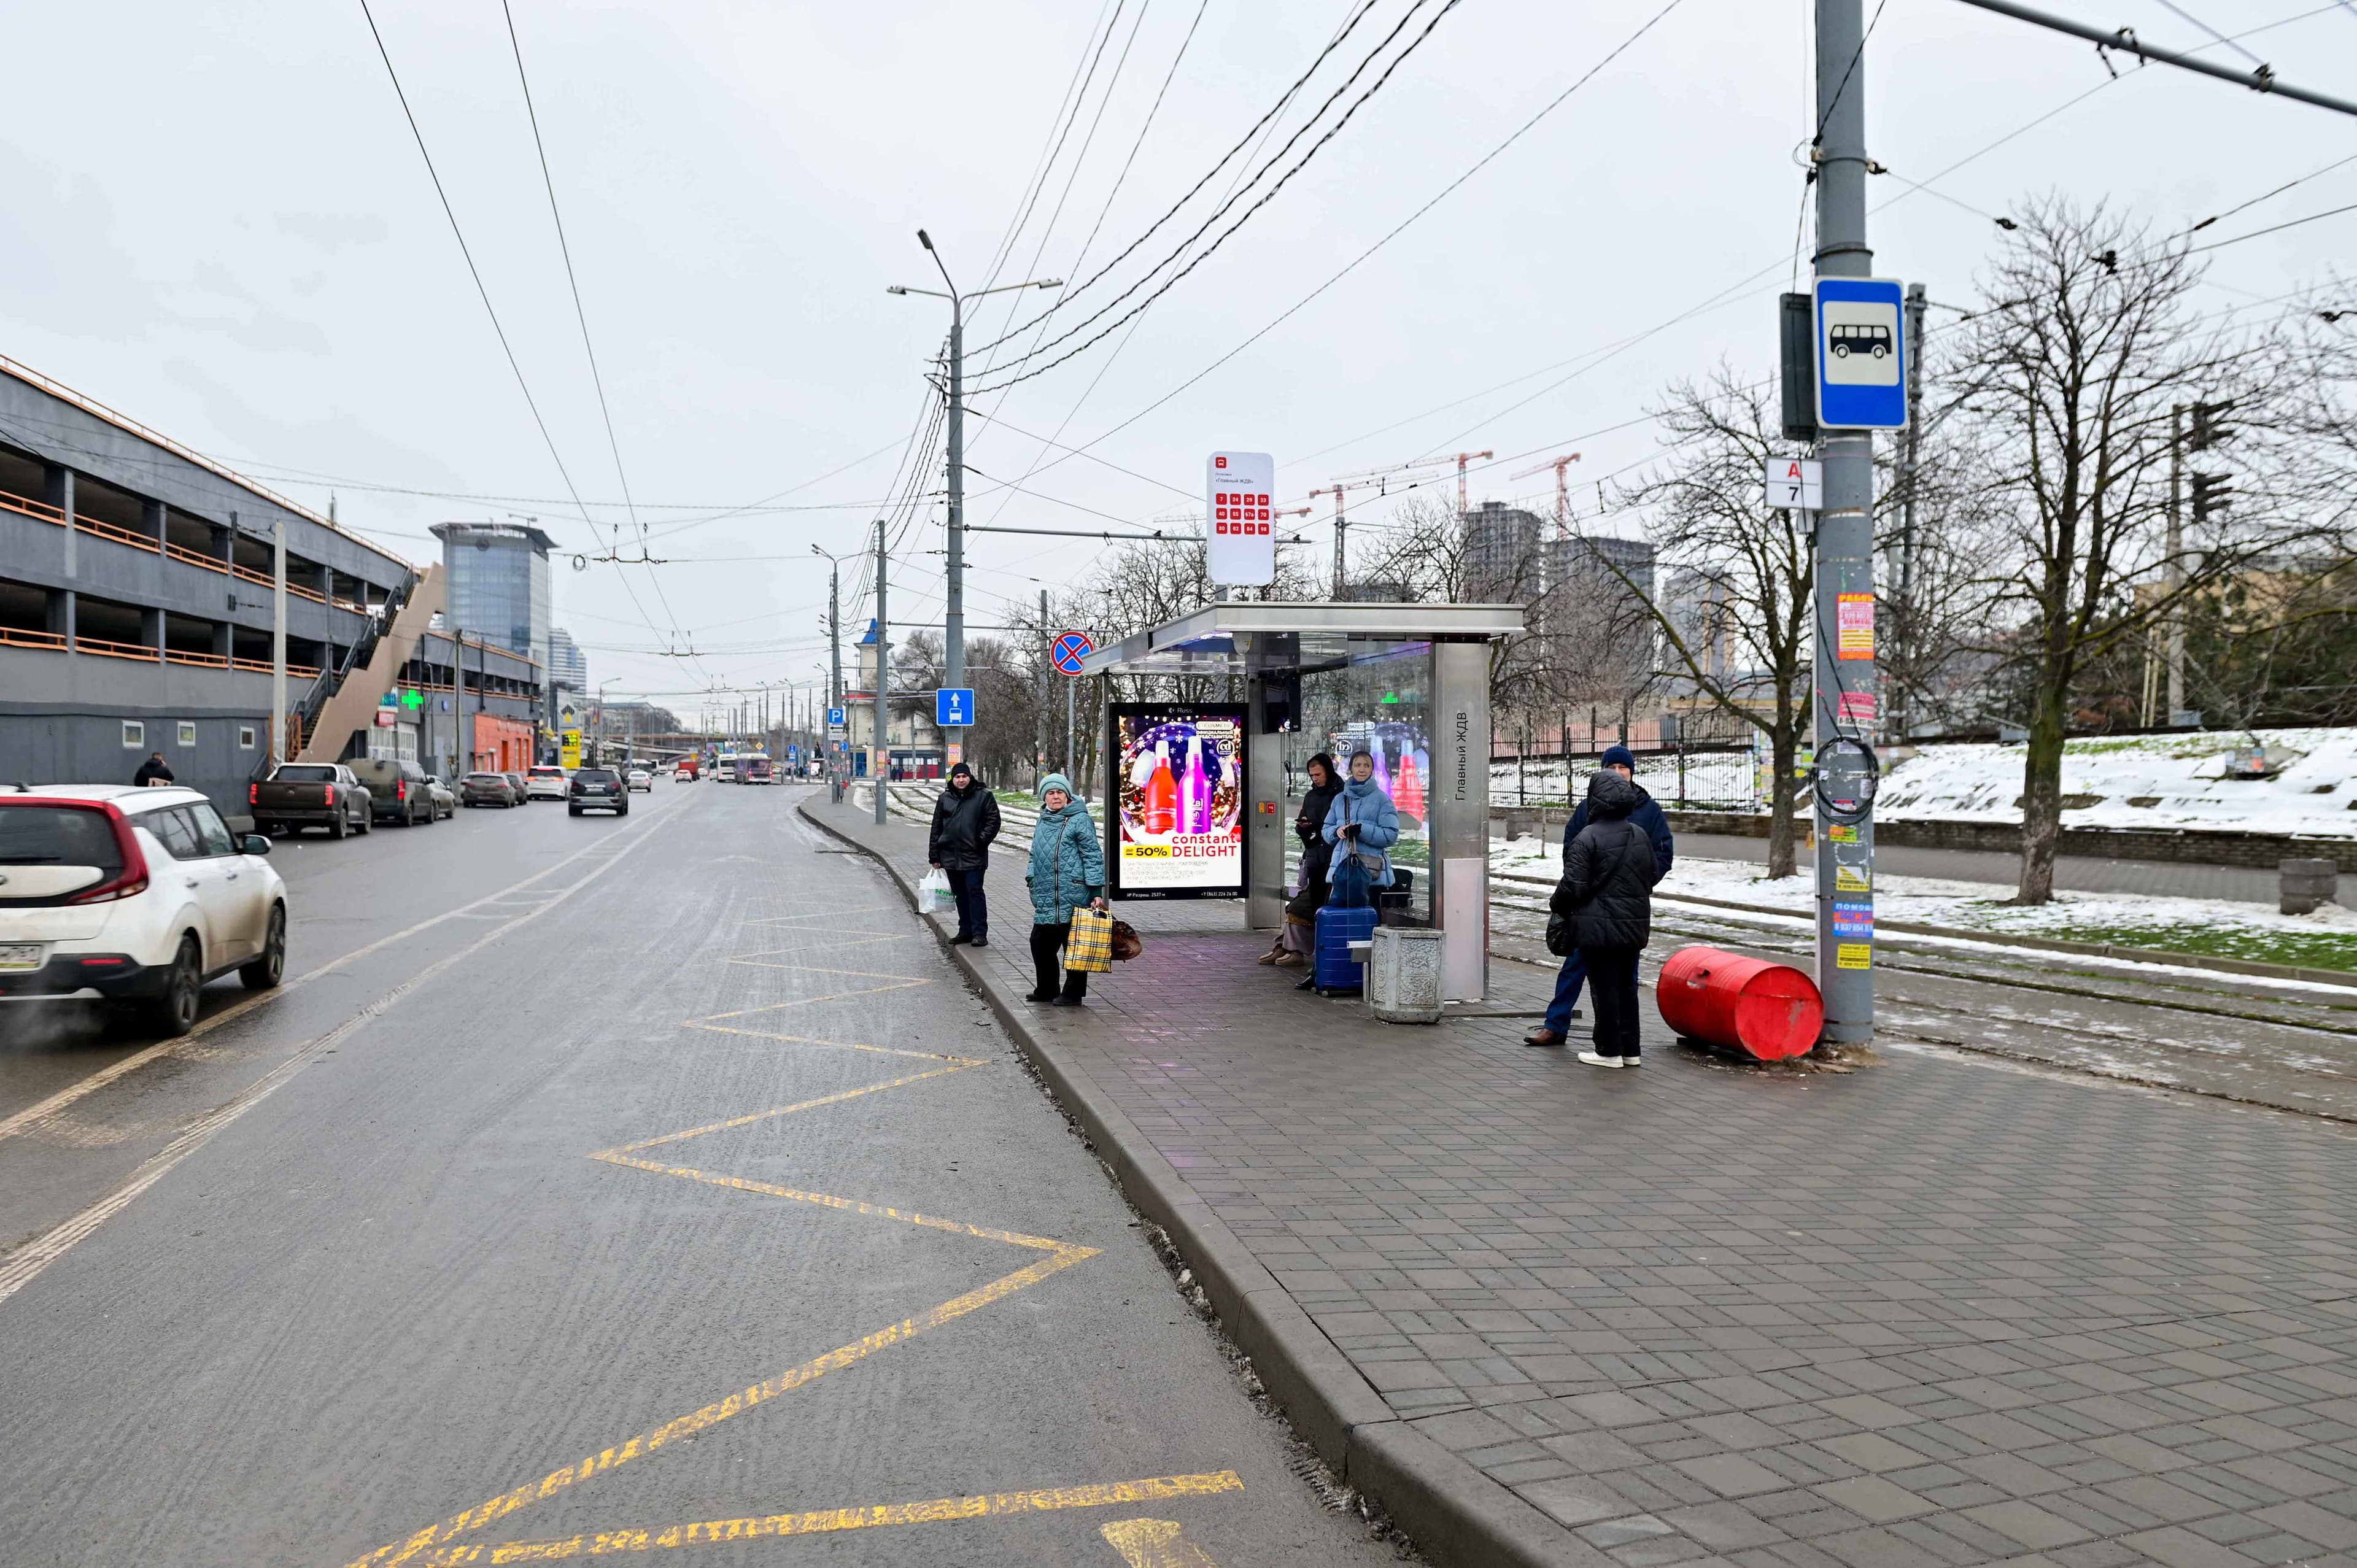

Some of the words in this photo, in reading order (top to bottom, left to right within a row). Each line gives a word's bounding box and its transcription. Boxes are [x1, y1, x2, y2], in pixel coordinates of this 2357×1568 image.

[1789, 487, 1798, 501] 7
[832, 710, 841, 722] P
[1457, 713, 1468, 742] ЖДВ
[1455, 746, 1466, 800] Главный
[1172, 834, 1235, 844] constant
[1172, 846, 1237, 857] DELIGHT
